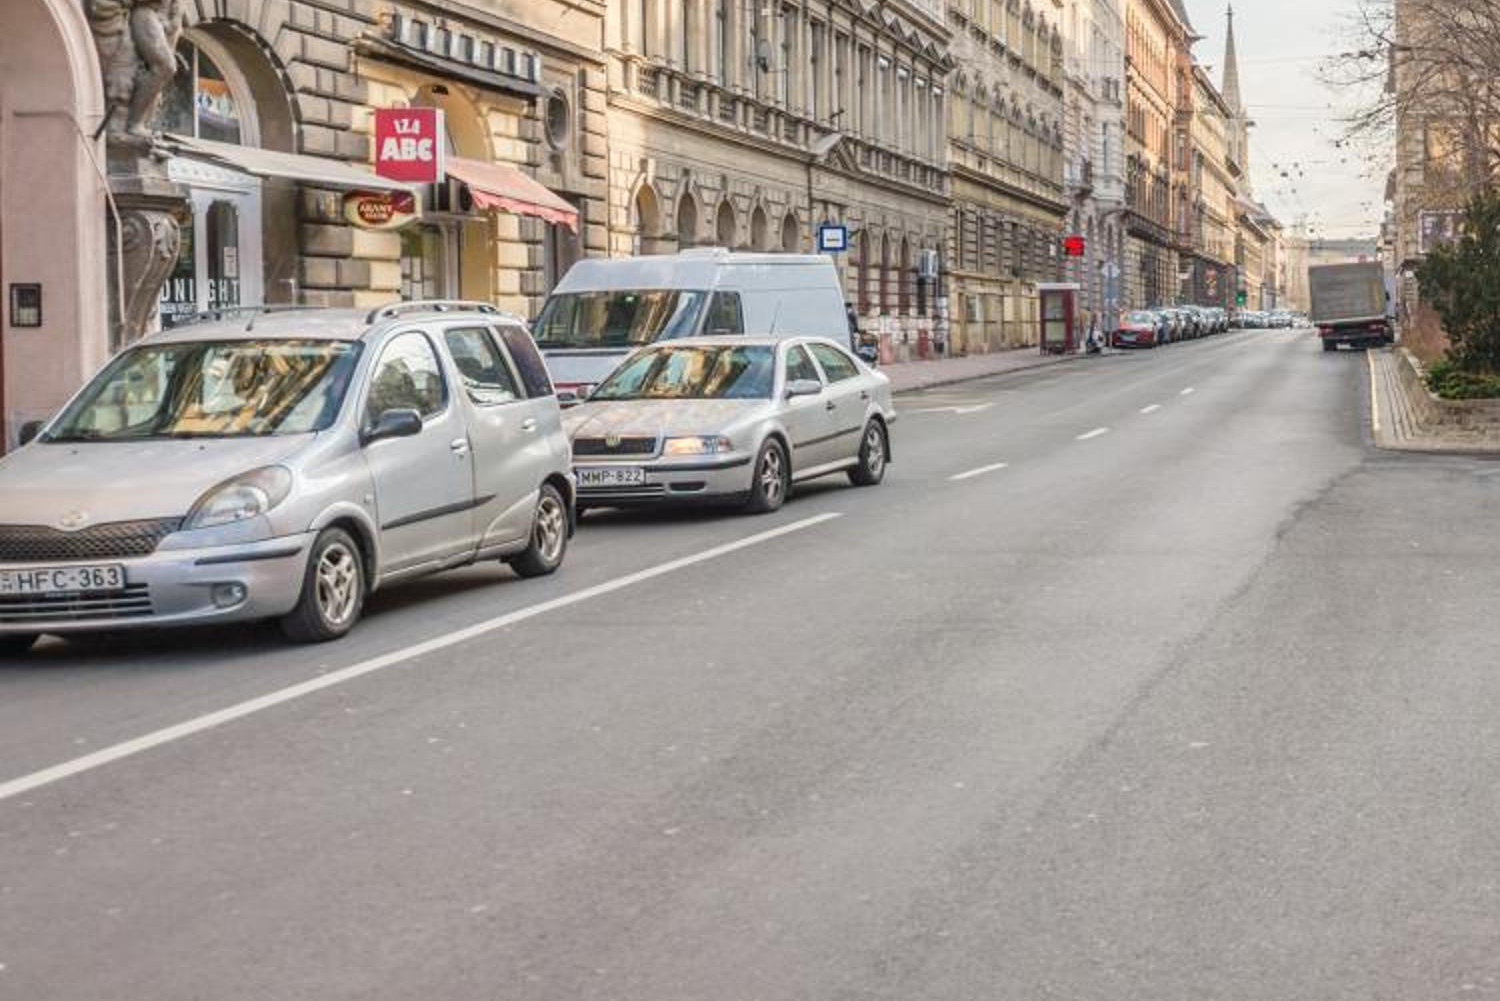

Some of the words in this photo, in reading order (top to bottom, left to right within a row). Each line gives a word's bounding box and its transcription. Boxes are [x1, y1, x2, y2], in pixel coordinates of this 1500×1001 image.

[381, 137, 433, 161] ABC
[581, 470, 641, 484] MMP-822
[17, 567, 120, 590] HFC-363
